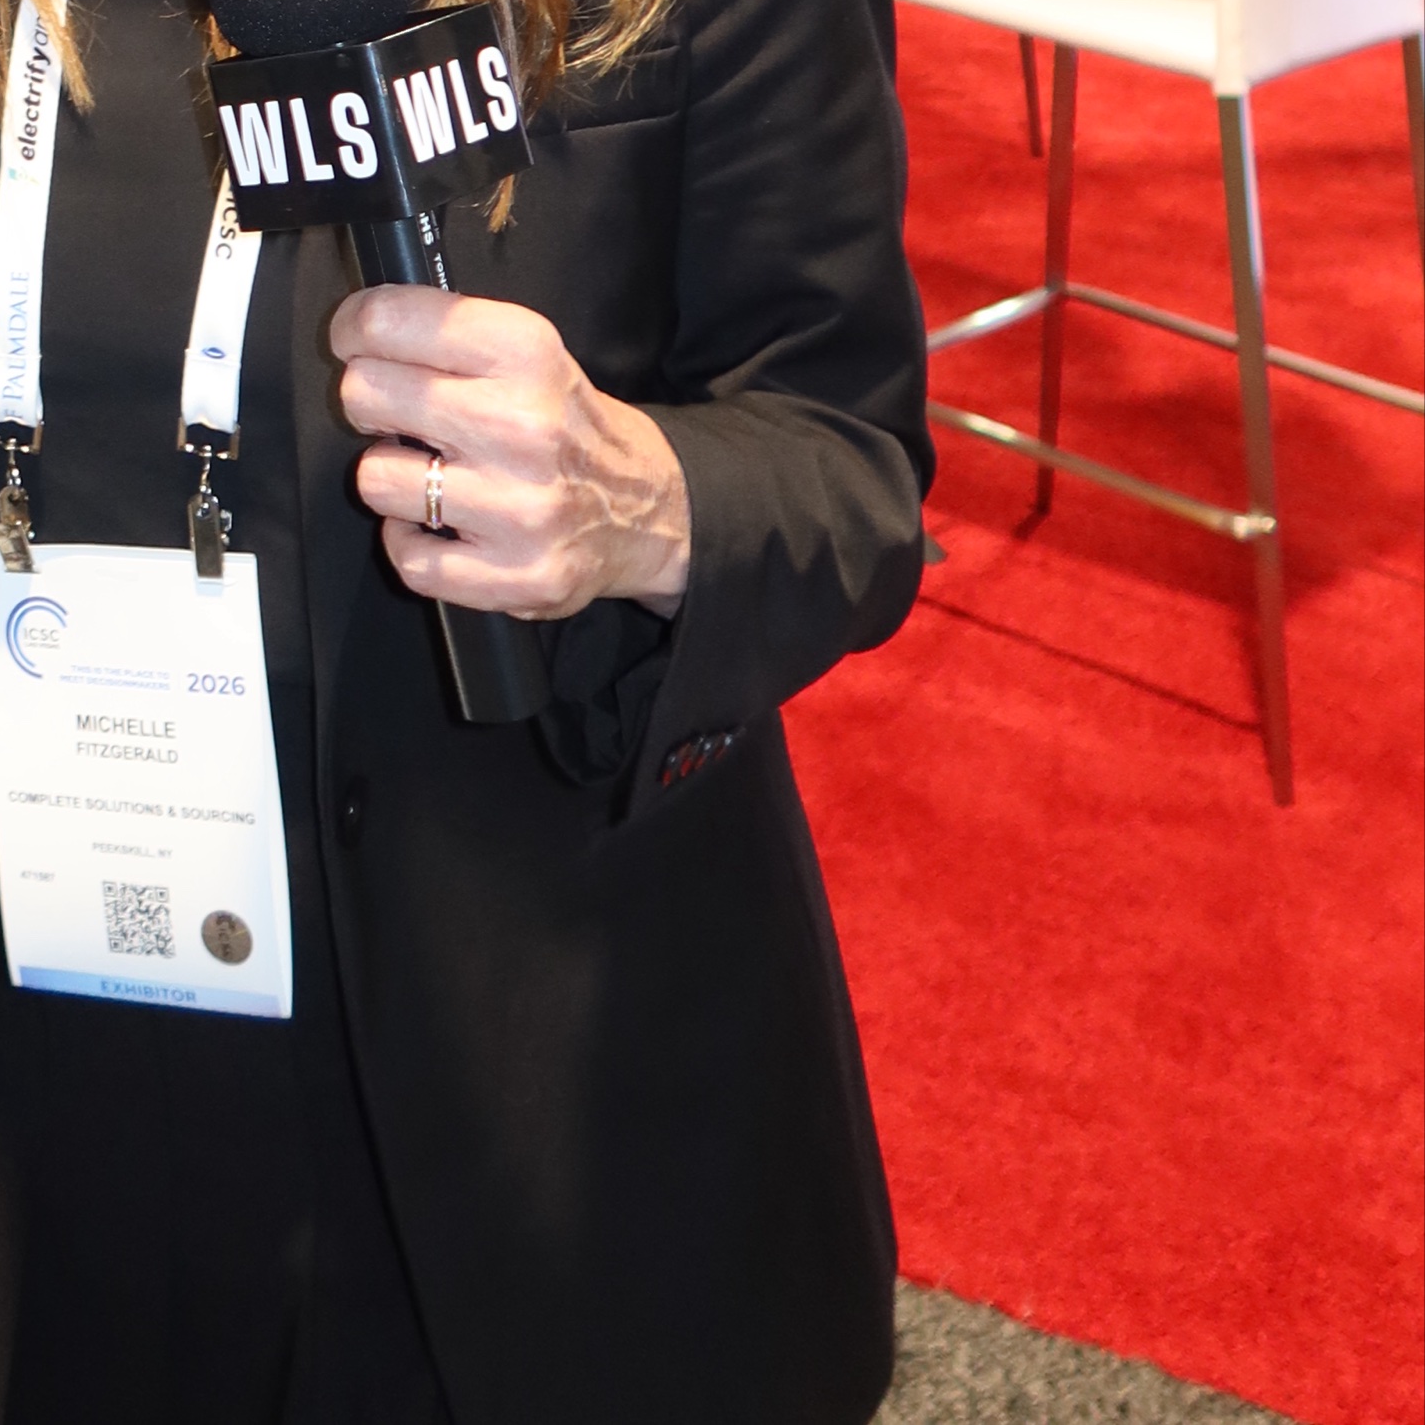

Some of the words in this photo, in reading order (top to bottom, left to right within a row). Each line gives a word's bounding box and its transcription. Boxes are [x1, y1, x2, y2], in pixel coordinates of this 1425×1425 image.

[393, 46, 517, 163] WLS
[219, 92, 378, 186] WLS
[1, 271, 30, 401] PALMDALE
[23, 627, 60, 642] ICSC
[187, 672, 246, 696] 2026
[76, 713, 177, 739] MICHELLE
[77, 741, 179, 764] FITZGERALD
[8, 790, 82, 809] COMPLETE
[85, 798, 164, 817] SOLUTIONS
[167, 806, 177, 818] &
[181, 806, 256, 825] SOURCING
[100, 980, 197, 1003] EXHIBITOR
